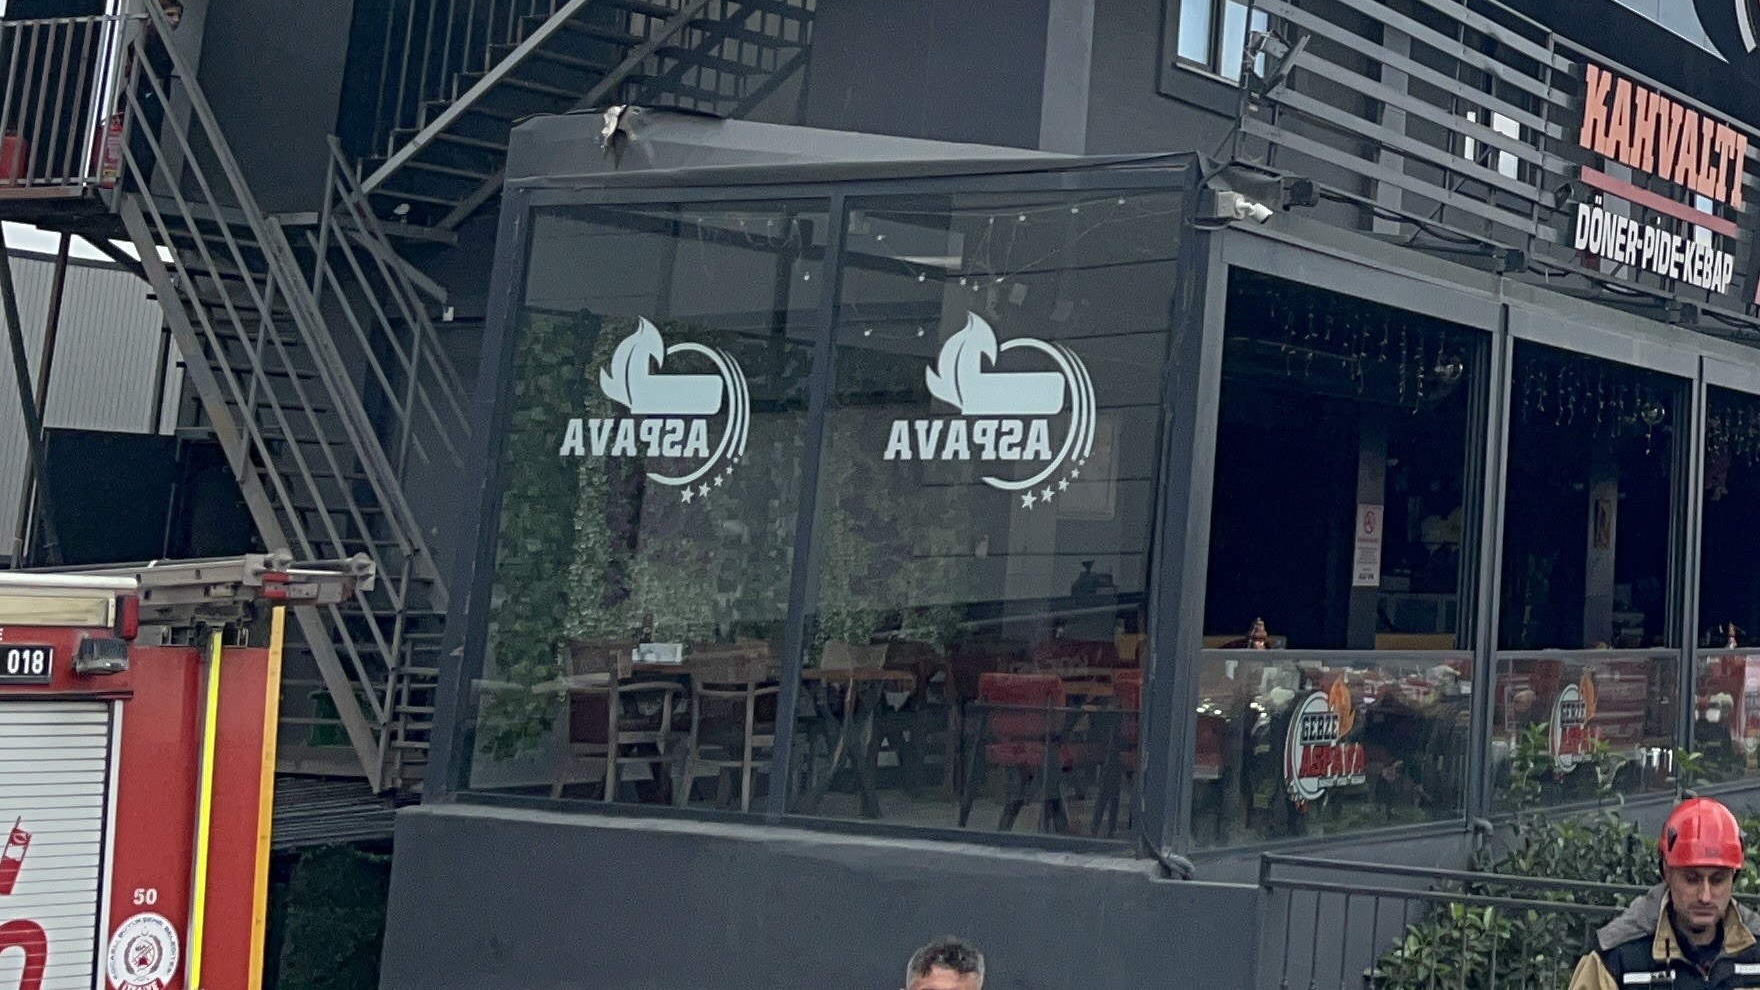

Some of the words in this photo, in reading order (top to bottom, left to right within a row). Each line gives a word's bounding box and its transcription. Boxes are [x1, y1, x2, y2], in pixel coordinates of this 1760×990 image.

[1579, 62, 1748, 208] KAHVALTI
[7, 649, 44, 674] 018
[1301, 714, 1339, 741] GEBZE
[1298, 743, 1366, 779] ASPAVA
[133, 887, 158, 906] 50
